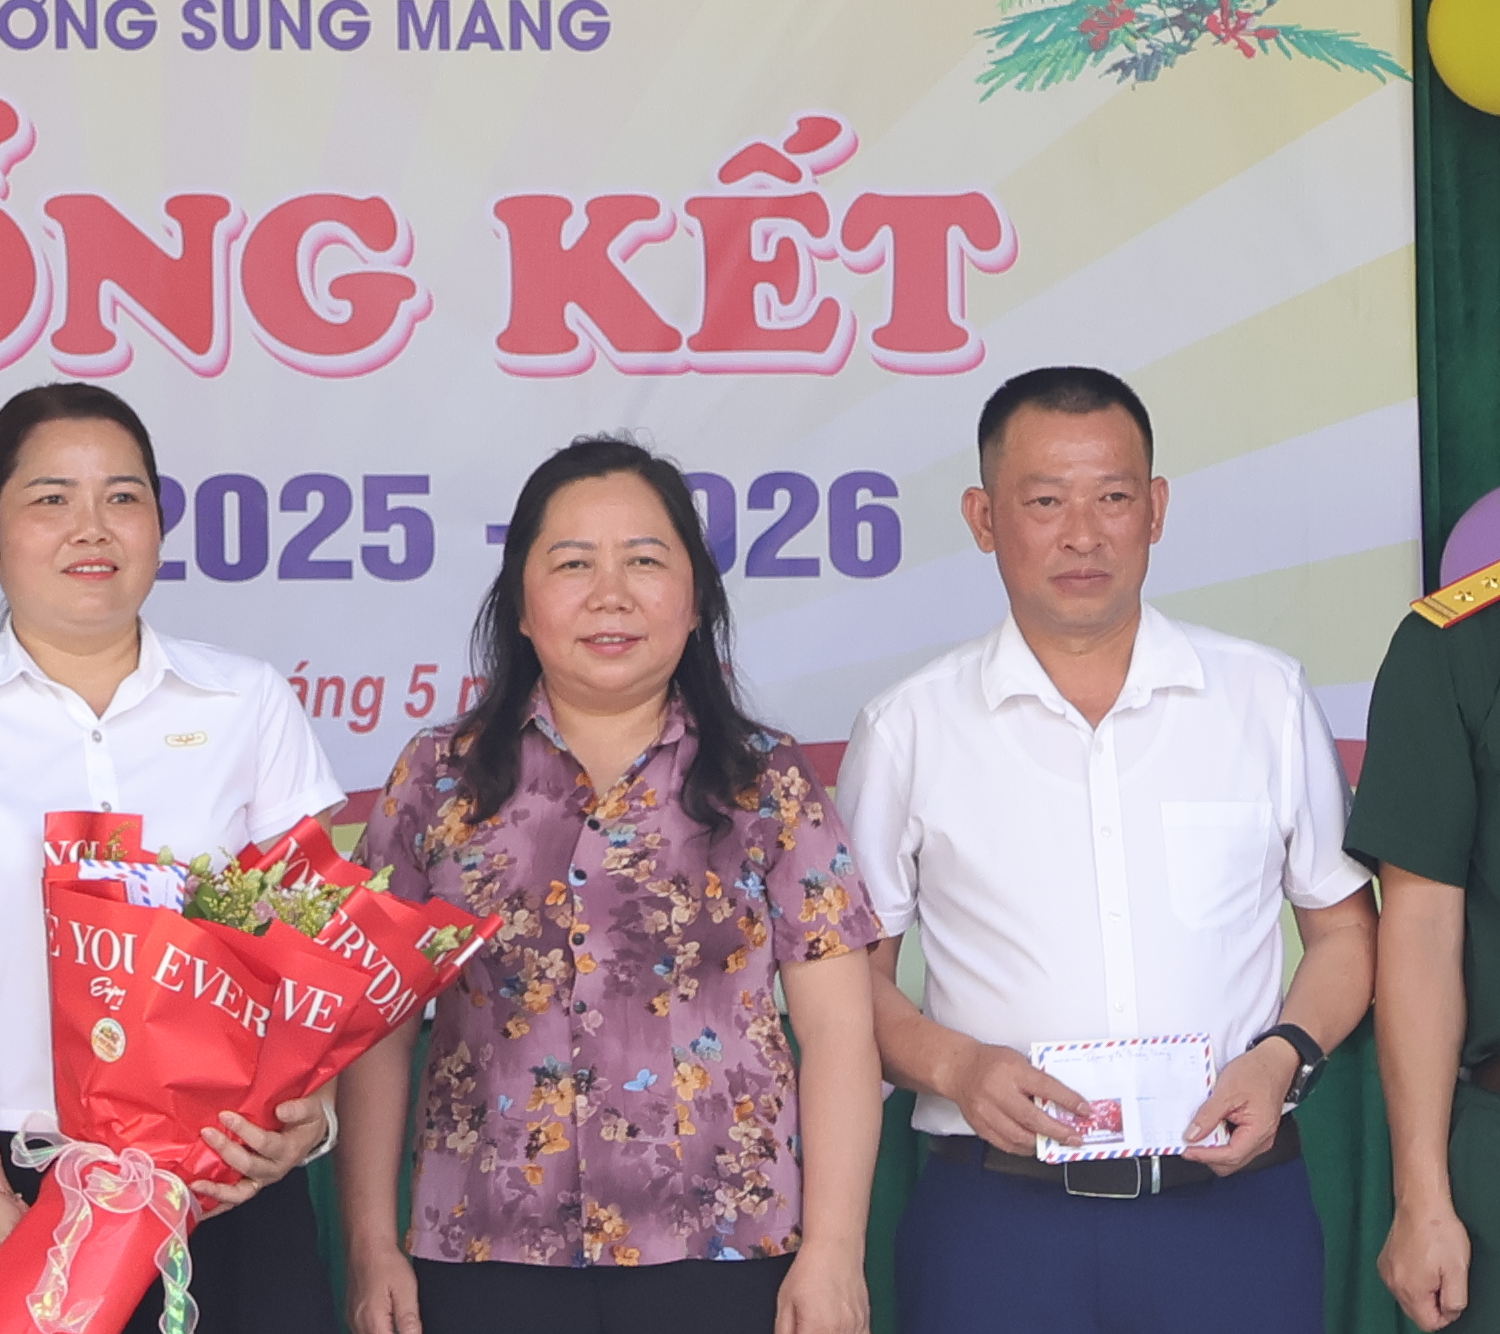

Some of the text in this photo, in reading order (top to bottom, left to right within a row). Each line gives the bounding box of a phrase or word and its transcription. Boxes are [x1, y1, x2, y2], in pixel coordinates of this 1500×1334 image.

[492, 114, 1019, 376] KẾT
[684, 471, 902, 579] 026
[404, 663, 439, 718] 5
